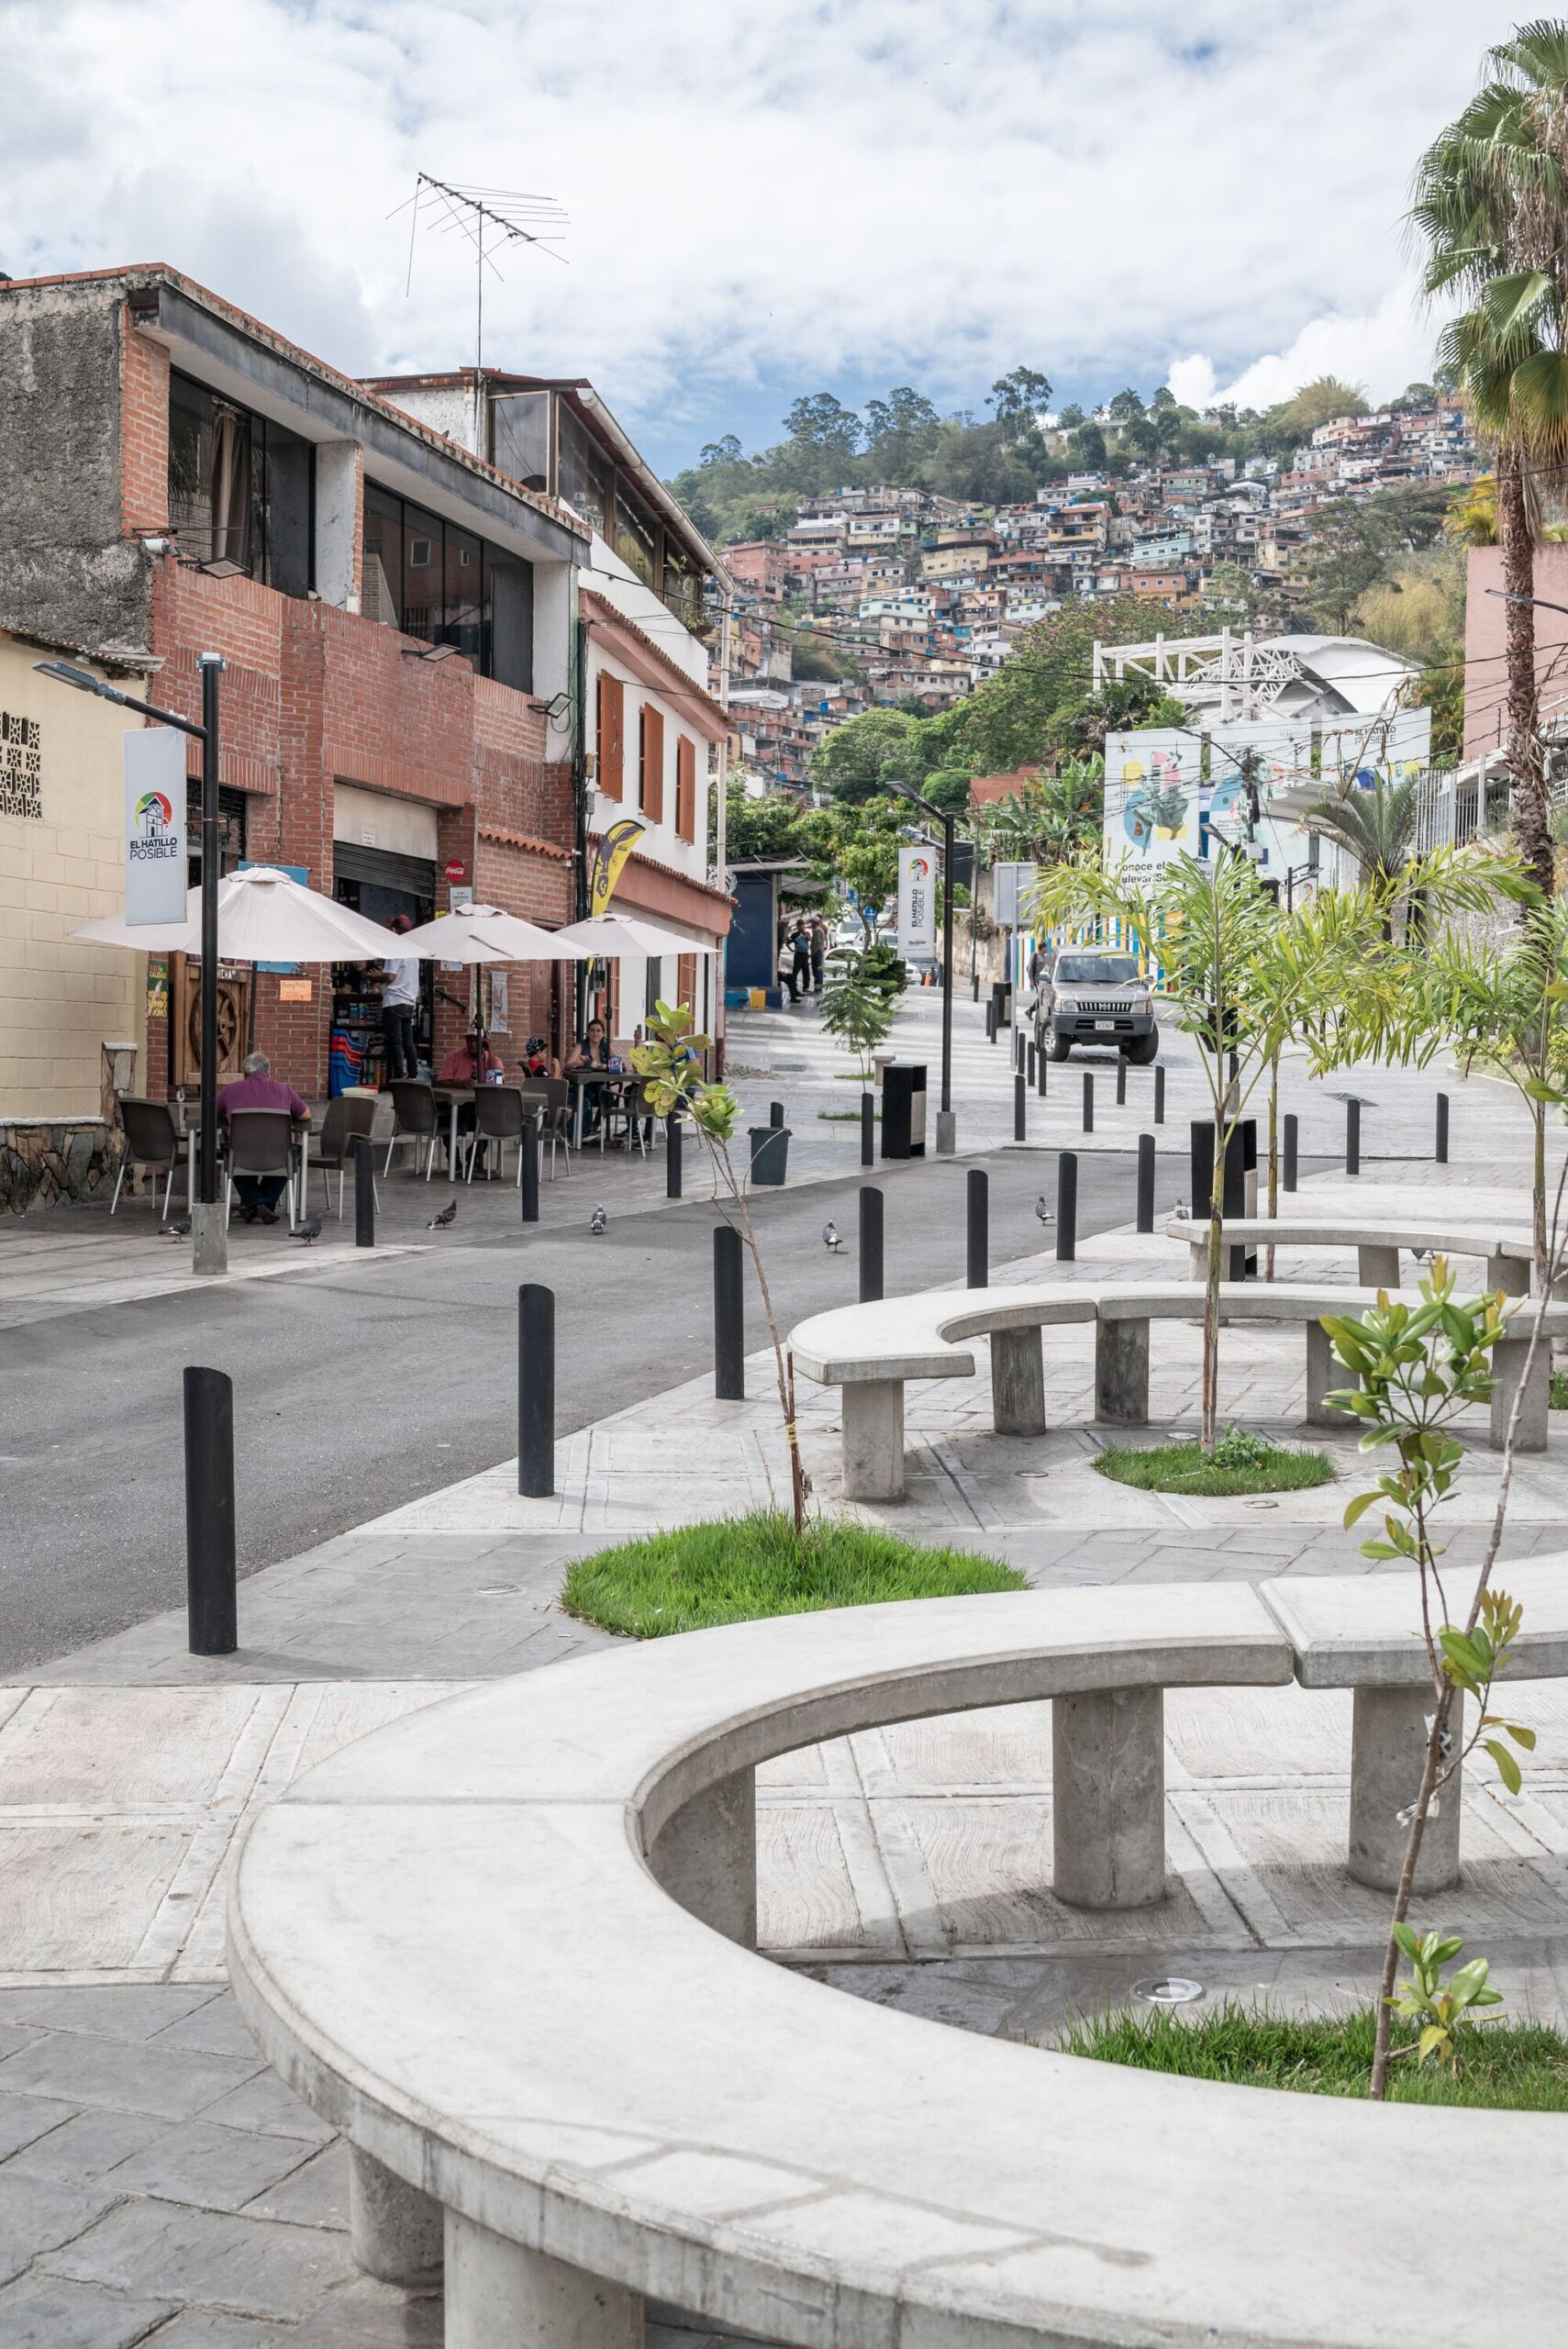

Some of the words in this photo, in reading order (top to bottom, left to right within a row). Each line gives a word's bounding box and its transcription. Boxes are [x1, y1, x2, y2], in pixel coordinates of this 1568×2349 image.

[130, 841, 140, 849] EL
[141, 837, 177, 848] HATILLO
[130, 846, 177, 861] POSIBLE
[1156, 861, 1165, 870] el
[1121, 874, 1151, 884] ulevar
[917, 888, 925, 928] POSIBLE
